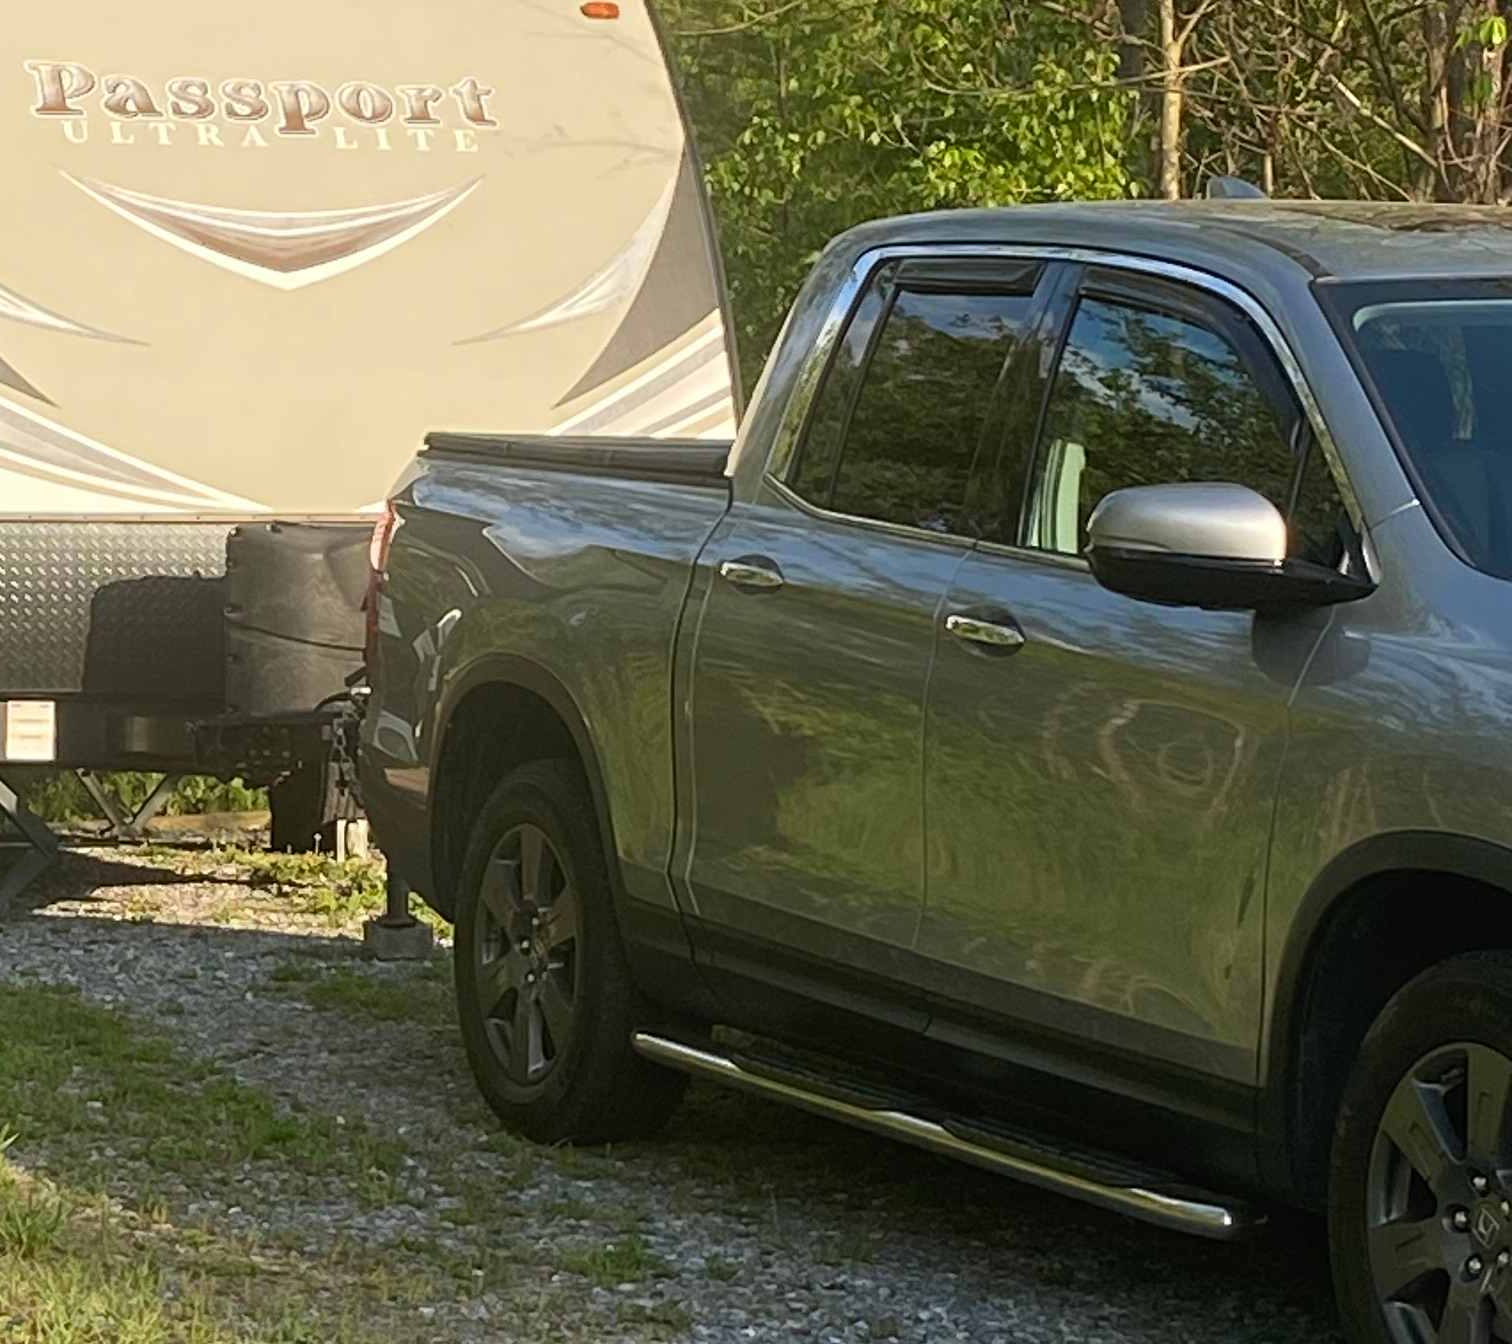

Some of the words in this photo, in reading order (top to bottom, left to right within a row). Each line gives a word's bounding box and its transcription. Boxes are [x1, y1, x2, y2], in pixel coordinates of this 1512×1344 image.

[25, 59, 499, 135] Passport
[63, 121, 270, 148] ULTRA
[334, 126, 480, 153] LITE
